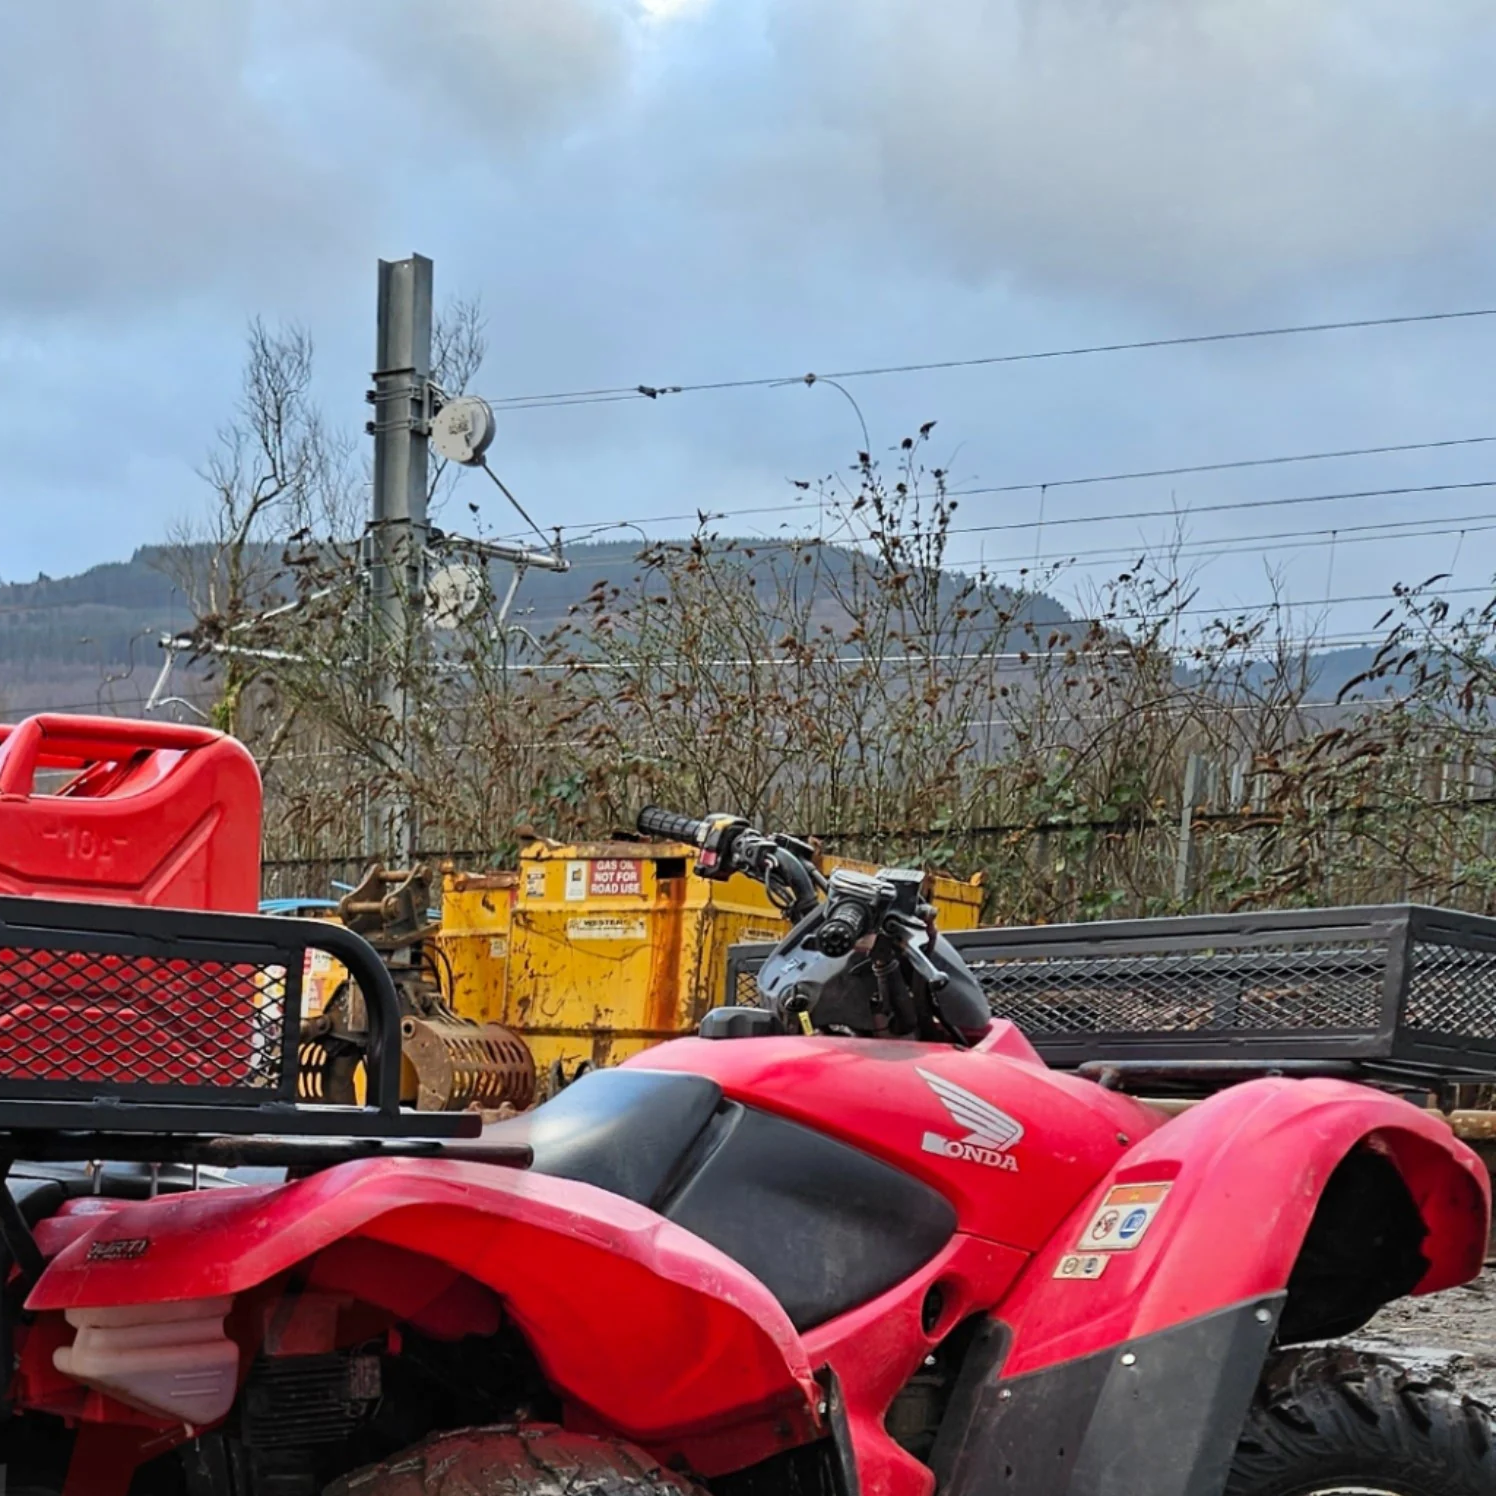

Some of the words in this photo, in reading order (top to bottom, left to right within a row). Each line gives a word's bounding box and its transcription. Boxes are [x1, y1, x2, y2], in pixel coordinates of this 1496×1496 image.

[596, 859, 618, 871] GAS
[619, 860, 637, 871] OIL
[593, 871, 614, 882] NOT
[616, 871, 637, 882] FOR
[590, 882, 619, 894] ROAD
[620, 882, 641, 894] USE
